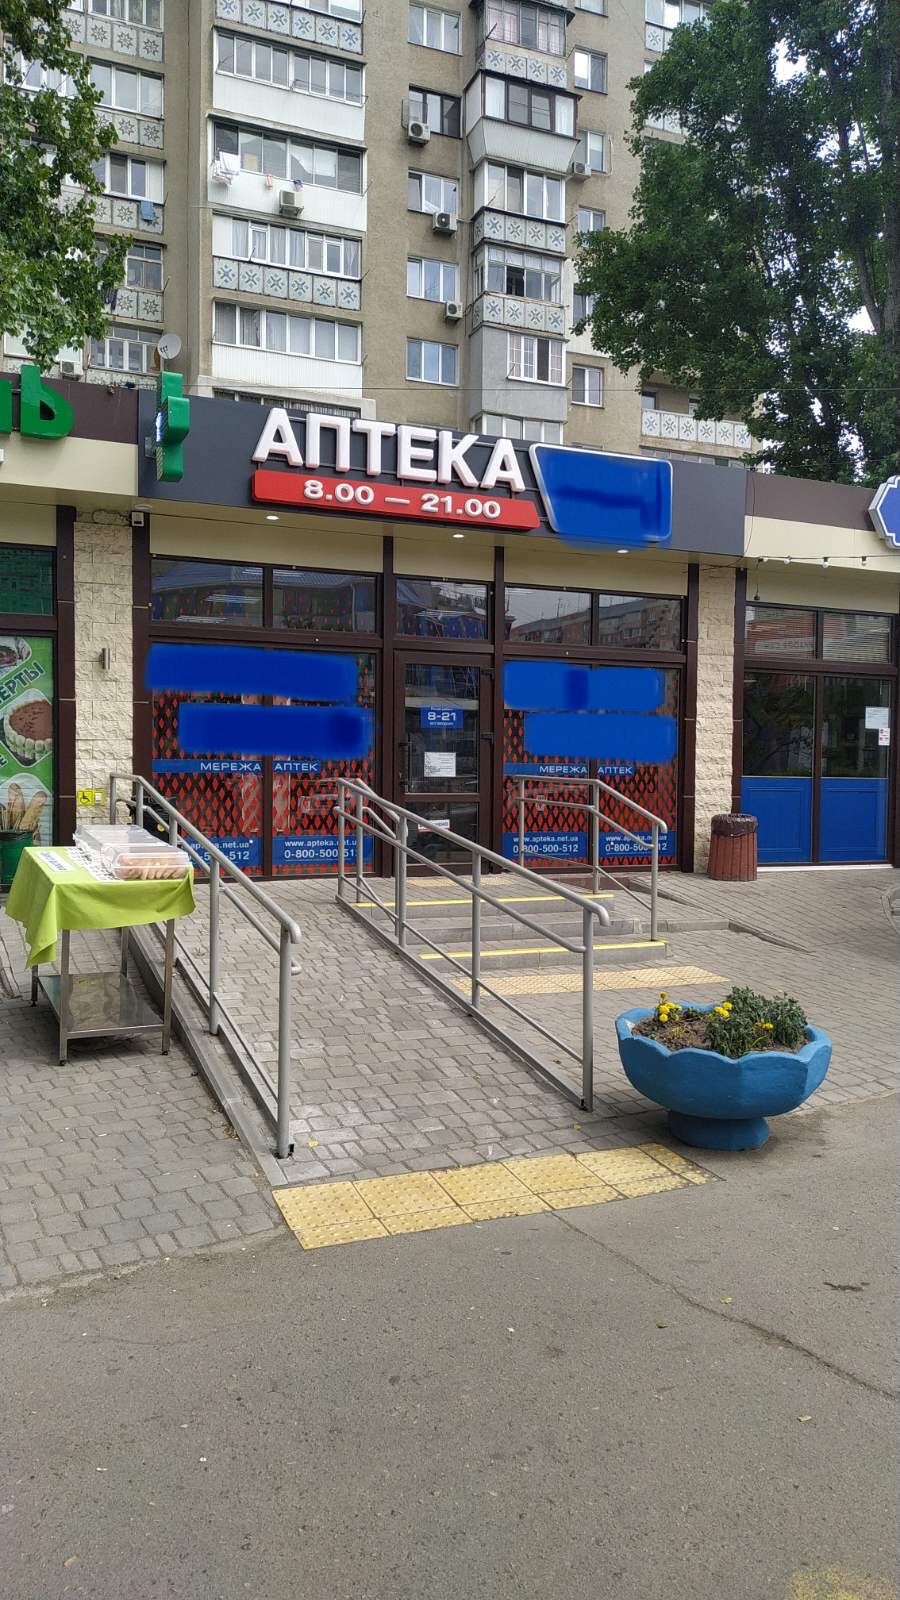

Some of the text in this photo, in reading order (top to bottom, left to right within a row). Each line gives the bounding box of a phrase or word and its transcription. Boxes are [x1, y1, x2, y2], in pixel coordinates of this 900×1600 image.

[252, 407, 526, 492] АПТЕКА
[303, 479, 374, 505] 8.00
[421, 493, 501, 519] 21.00
[427, 711, 457, 722] 8-21
[200, 761, 318, 772] МЕРЕЖА АПТЕК
[539, 765, 633, 775] МЕРЕЖА АПТЕК
